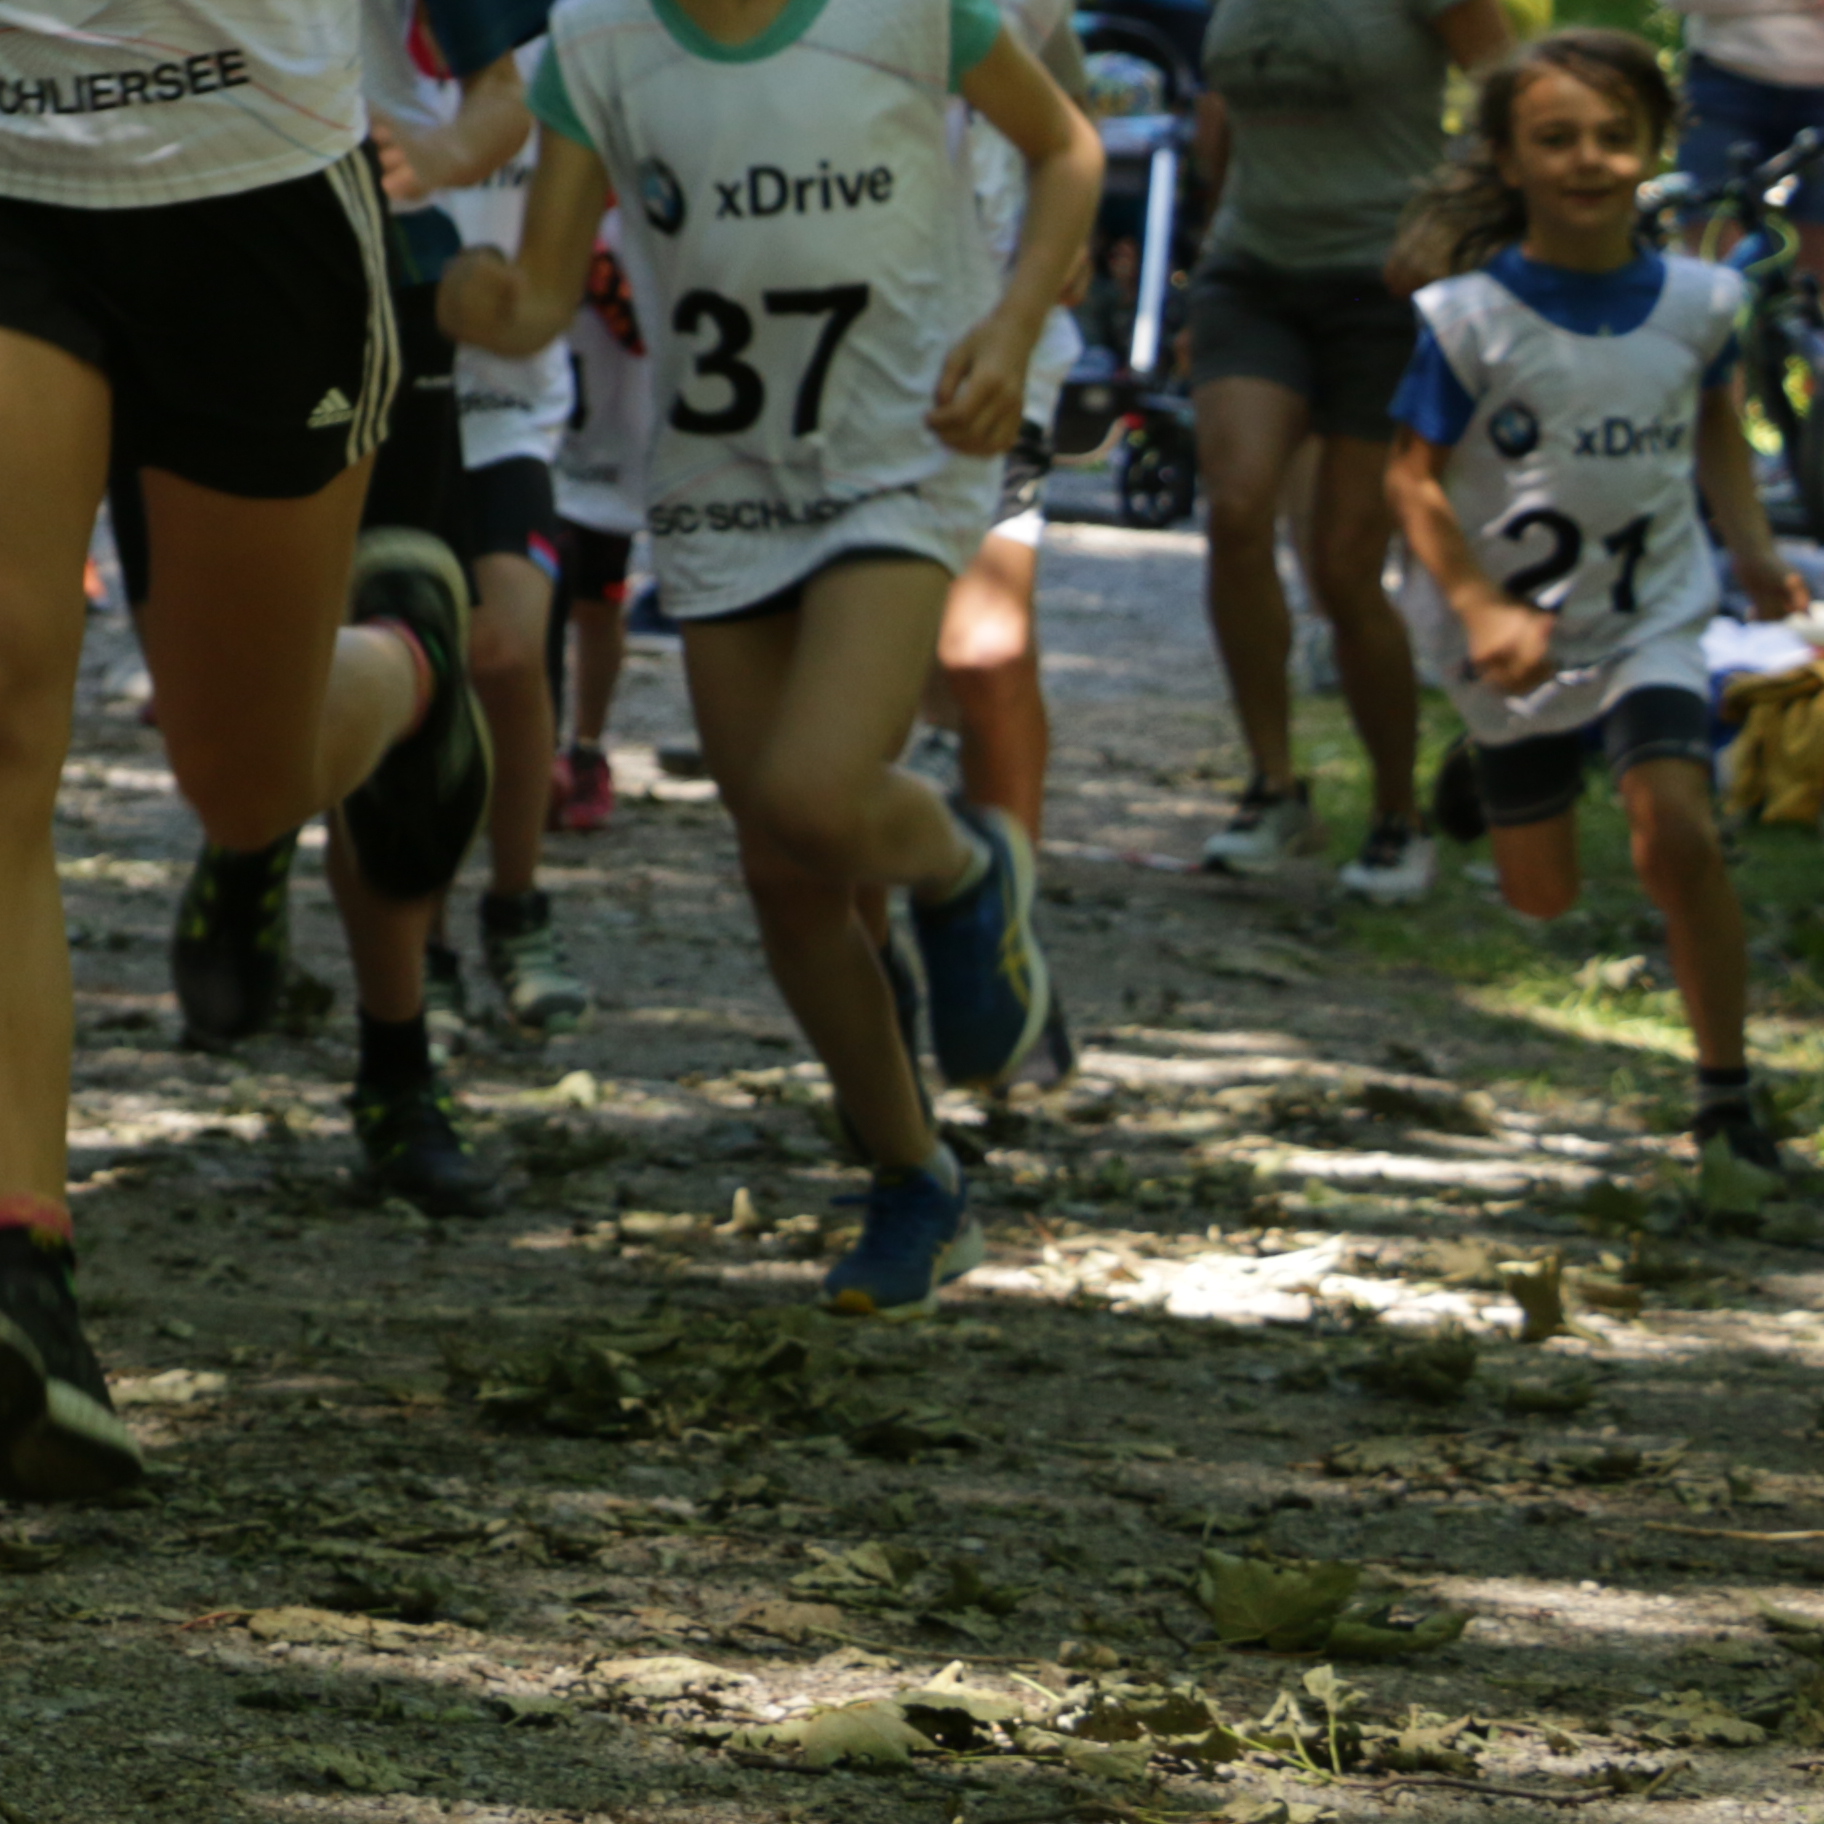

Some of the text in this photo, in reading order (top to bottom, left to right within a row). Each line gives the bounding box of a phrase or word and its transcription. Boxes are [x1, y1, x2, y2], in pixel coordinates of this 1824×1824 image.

[715, 160, 894, 220] xDrive
[669, 283, 872, 438] 37
[647, 502, 700, 537] SC
[1500, 508, 1655, 613] 21
